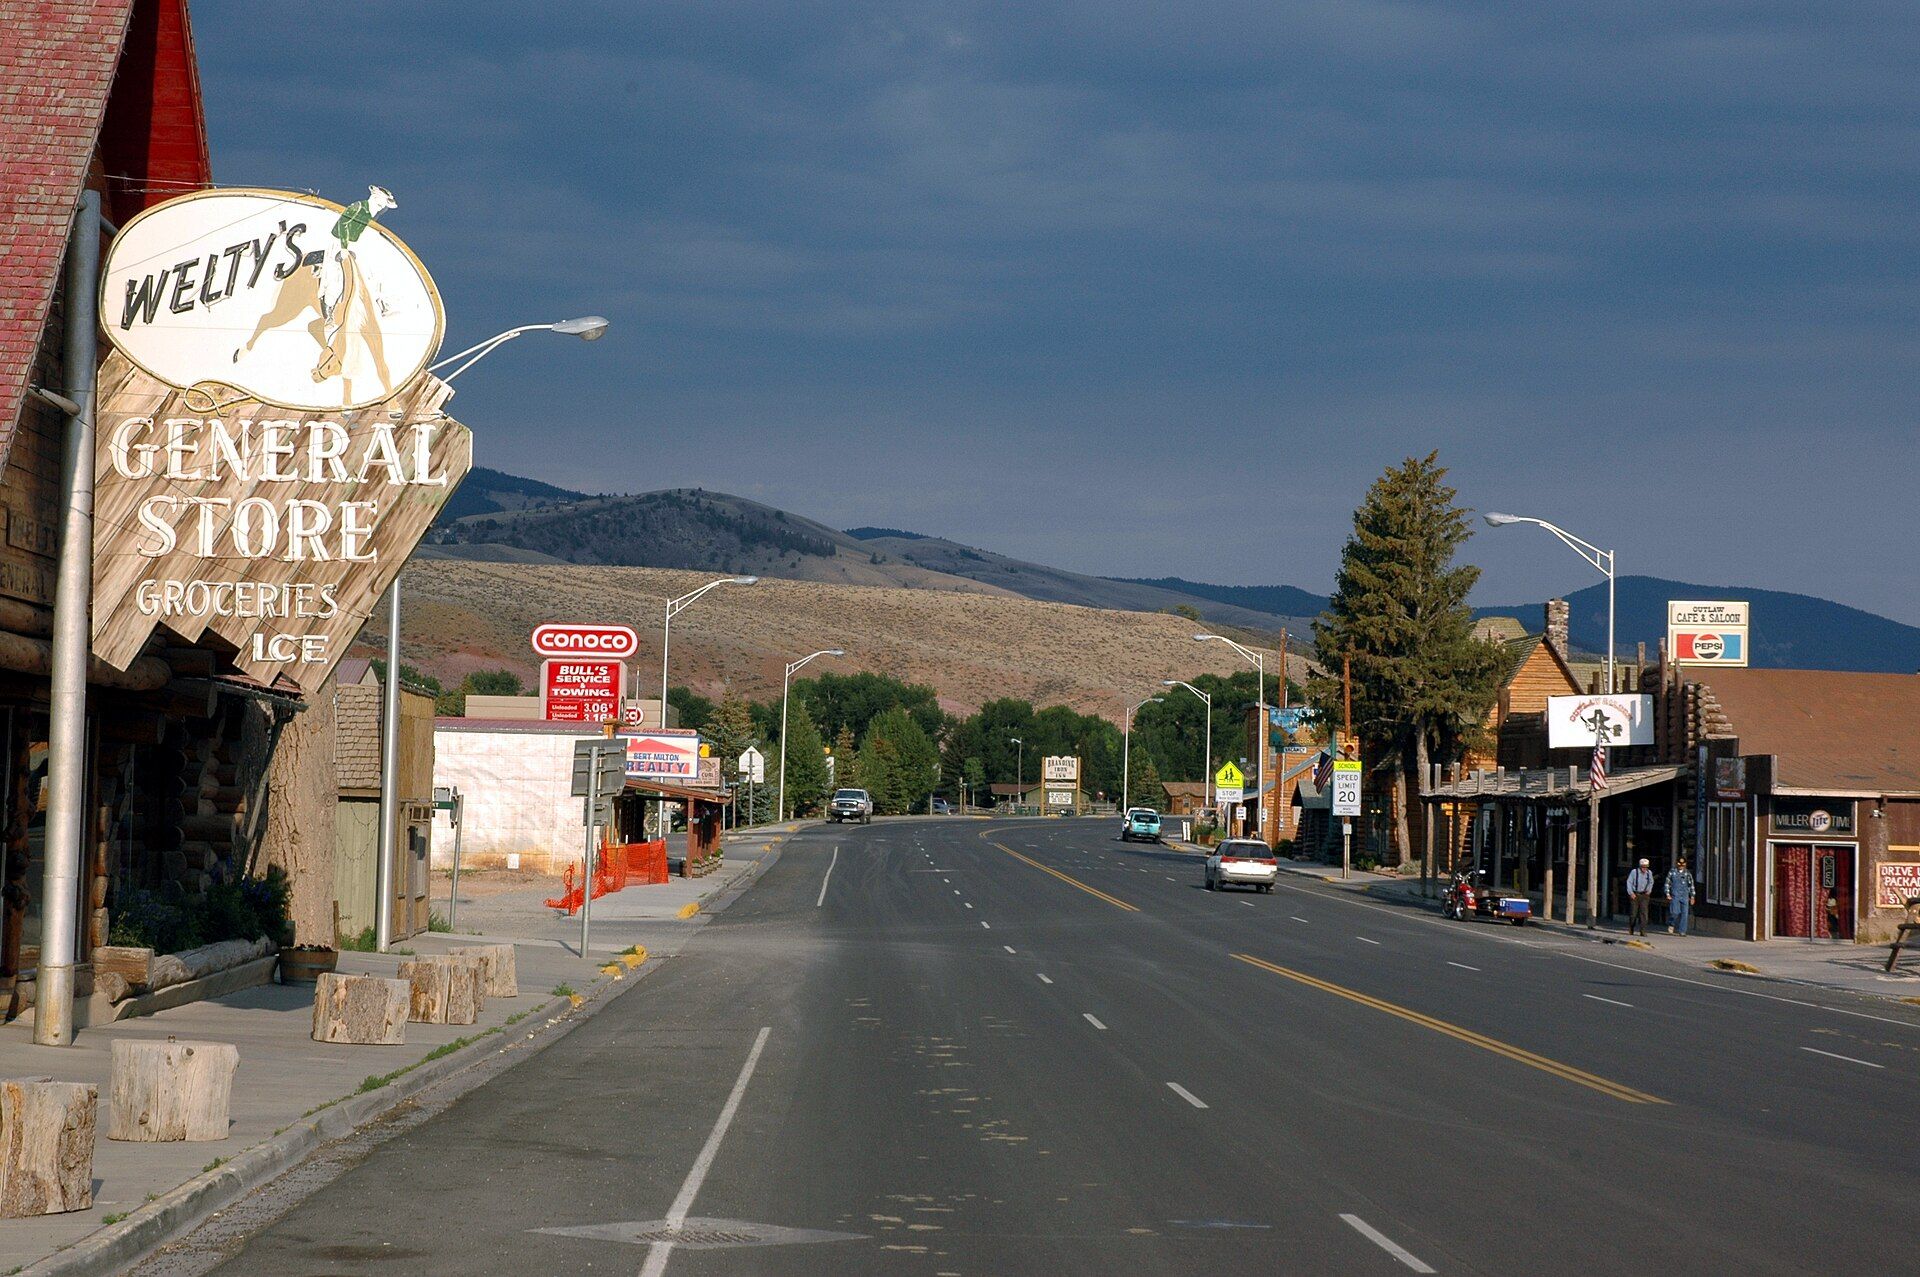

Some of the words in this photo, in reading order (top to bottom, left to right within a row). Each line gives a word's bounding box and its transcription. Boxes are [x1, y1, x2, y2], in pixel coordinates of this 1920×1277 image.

[121, 220, 307, 331] WELTY'S
[108, 416, 448, 487] GENERAL
[136, 495, 379, 564] STORE
[136, 579, 338, 620] GROCERIES
[1676, 613, 1699, 623] CAFE
[1708, 613, 1741, 623] SALOON
[252, 633, 330, 664] ICE
[1694, 642, 1723, 650] PEPSI
[559, 665, 608, 675] BULL'S
[556, 675, 611, 683] SERVICE
[551, 688, 610, 697] TOWING
[633, 752, 651, 760] BERT
[626, 761, 686, 773] REALTY
[1338, 791, 1356, 803] 20
[1776, 814, 1809, 826] MILLER
[1881, 866, 1913, 876] DRIVE
